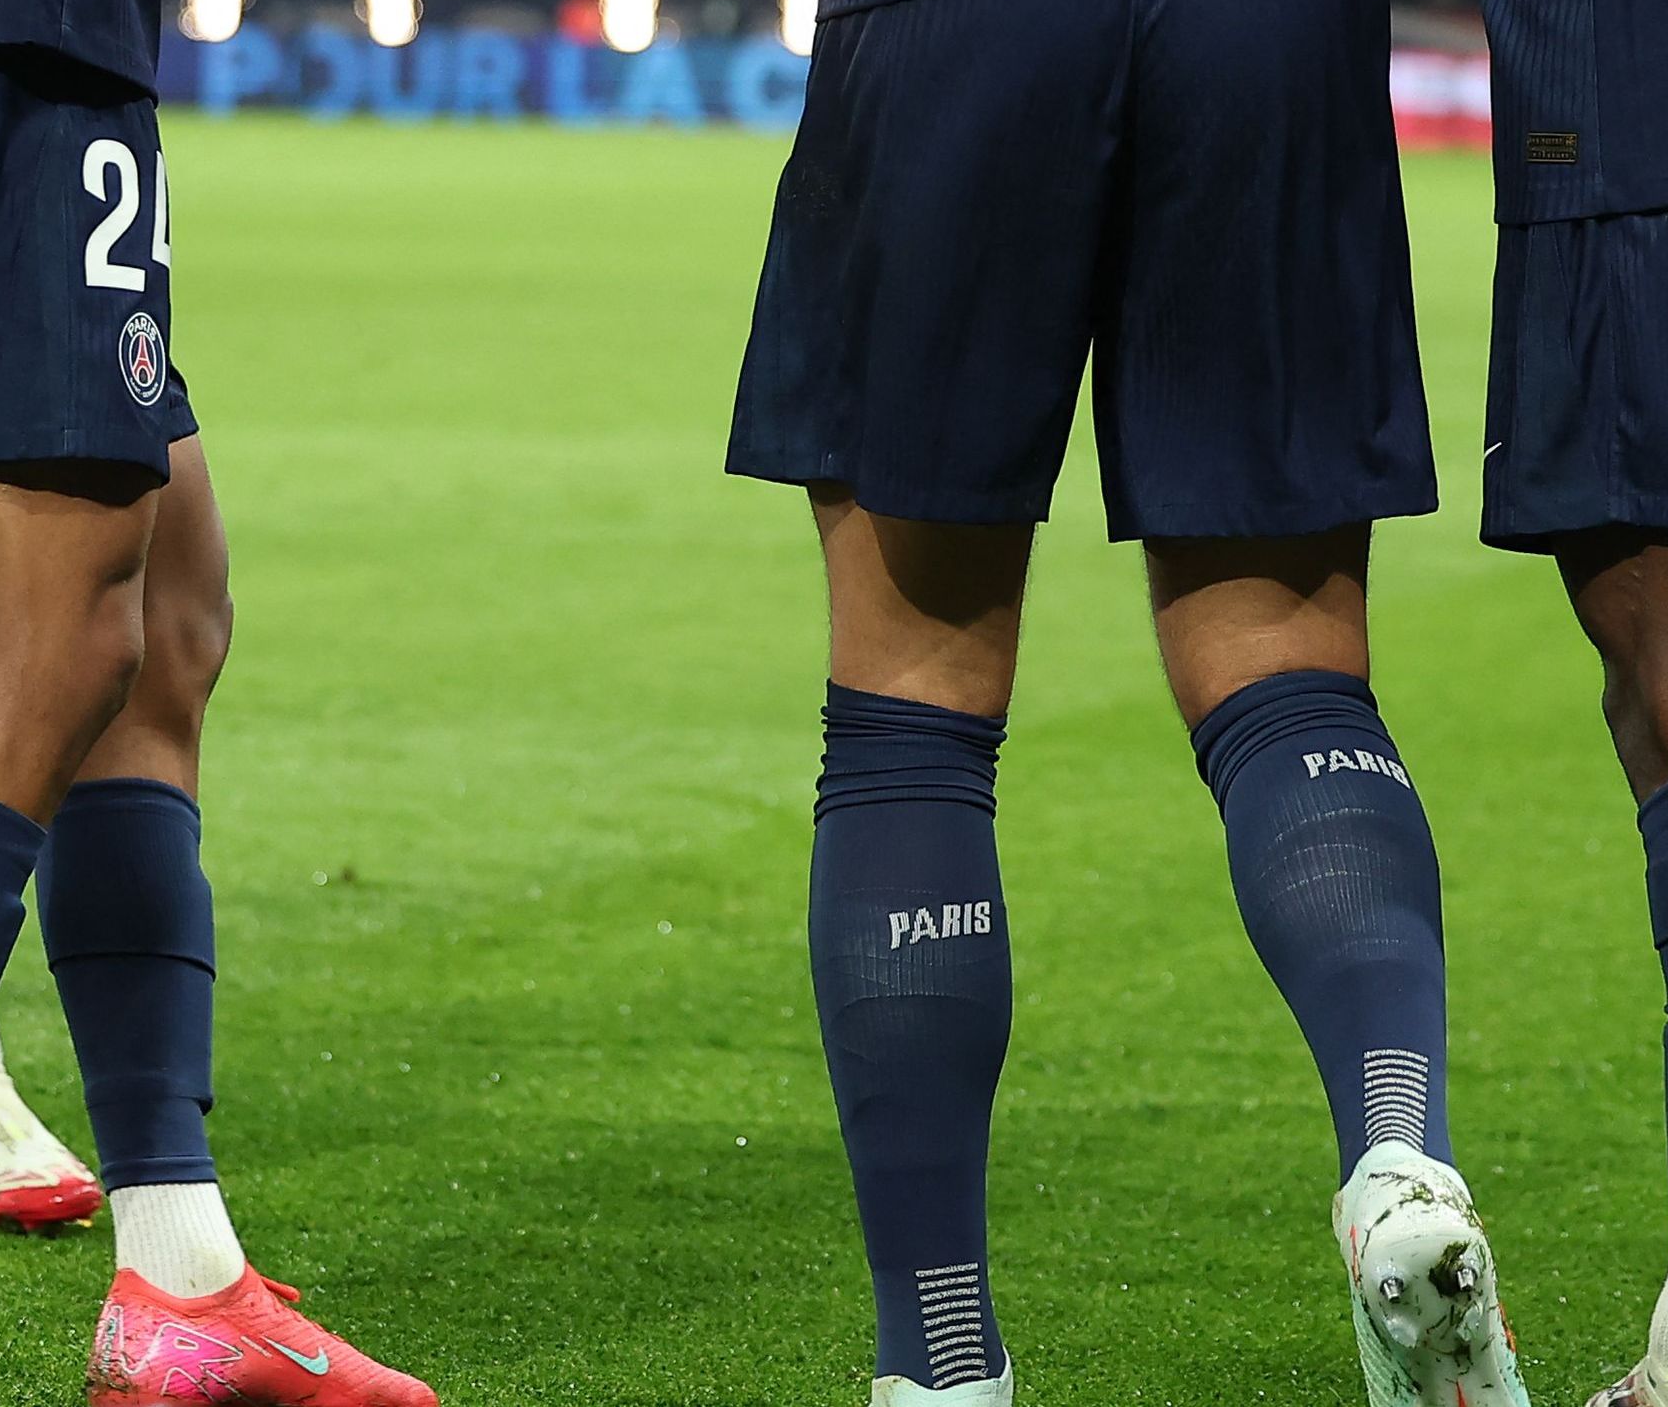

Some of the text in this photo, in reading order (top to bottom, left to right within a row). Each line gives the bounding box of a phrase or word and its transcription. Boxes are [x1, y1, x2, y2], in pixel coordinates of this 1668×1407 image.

[127, 316, 158, 342] PARIS
[1303, 747, 1411, 790] PARIS
[888, 900, 992, 950] PARIS
